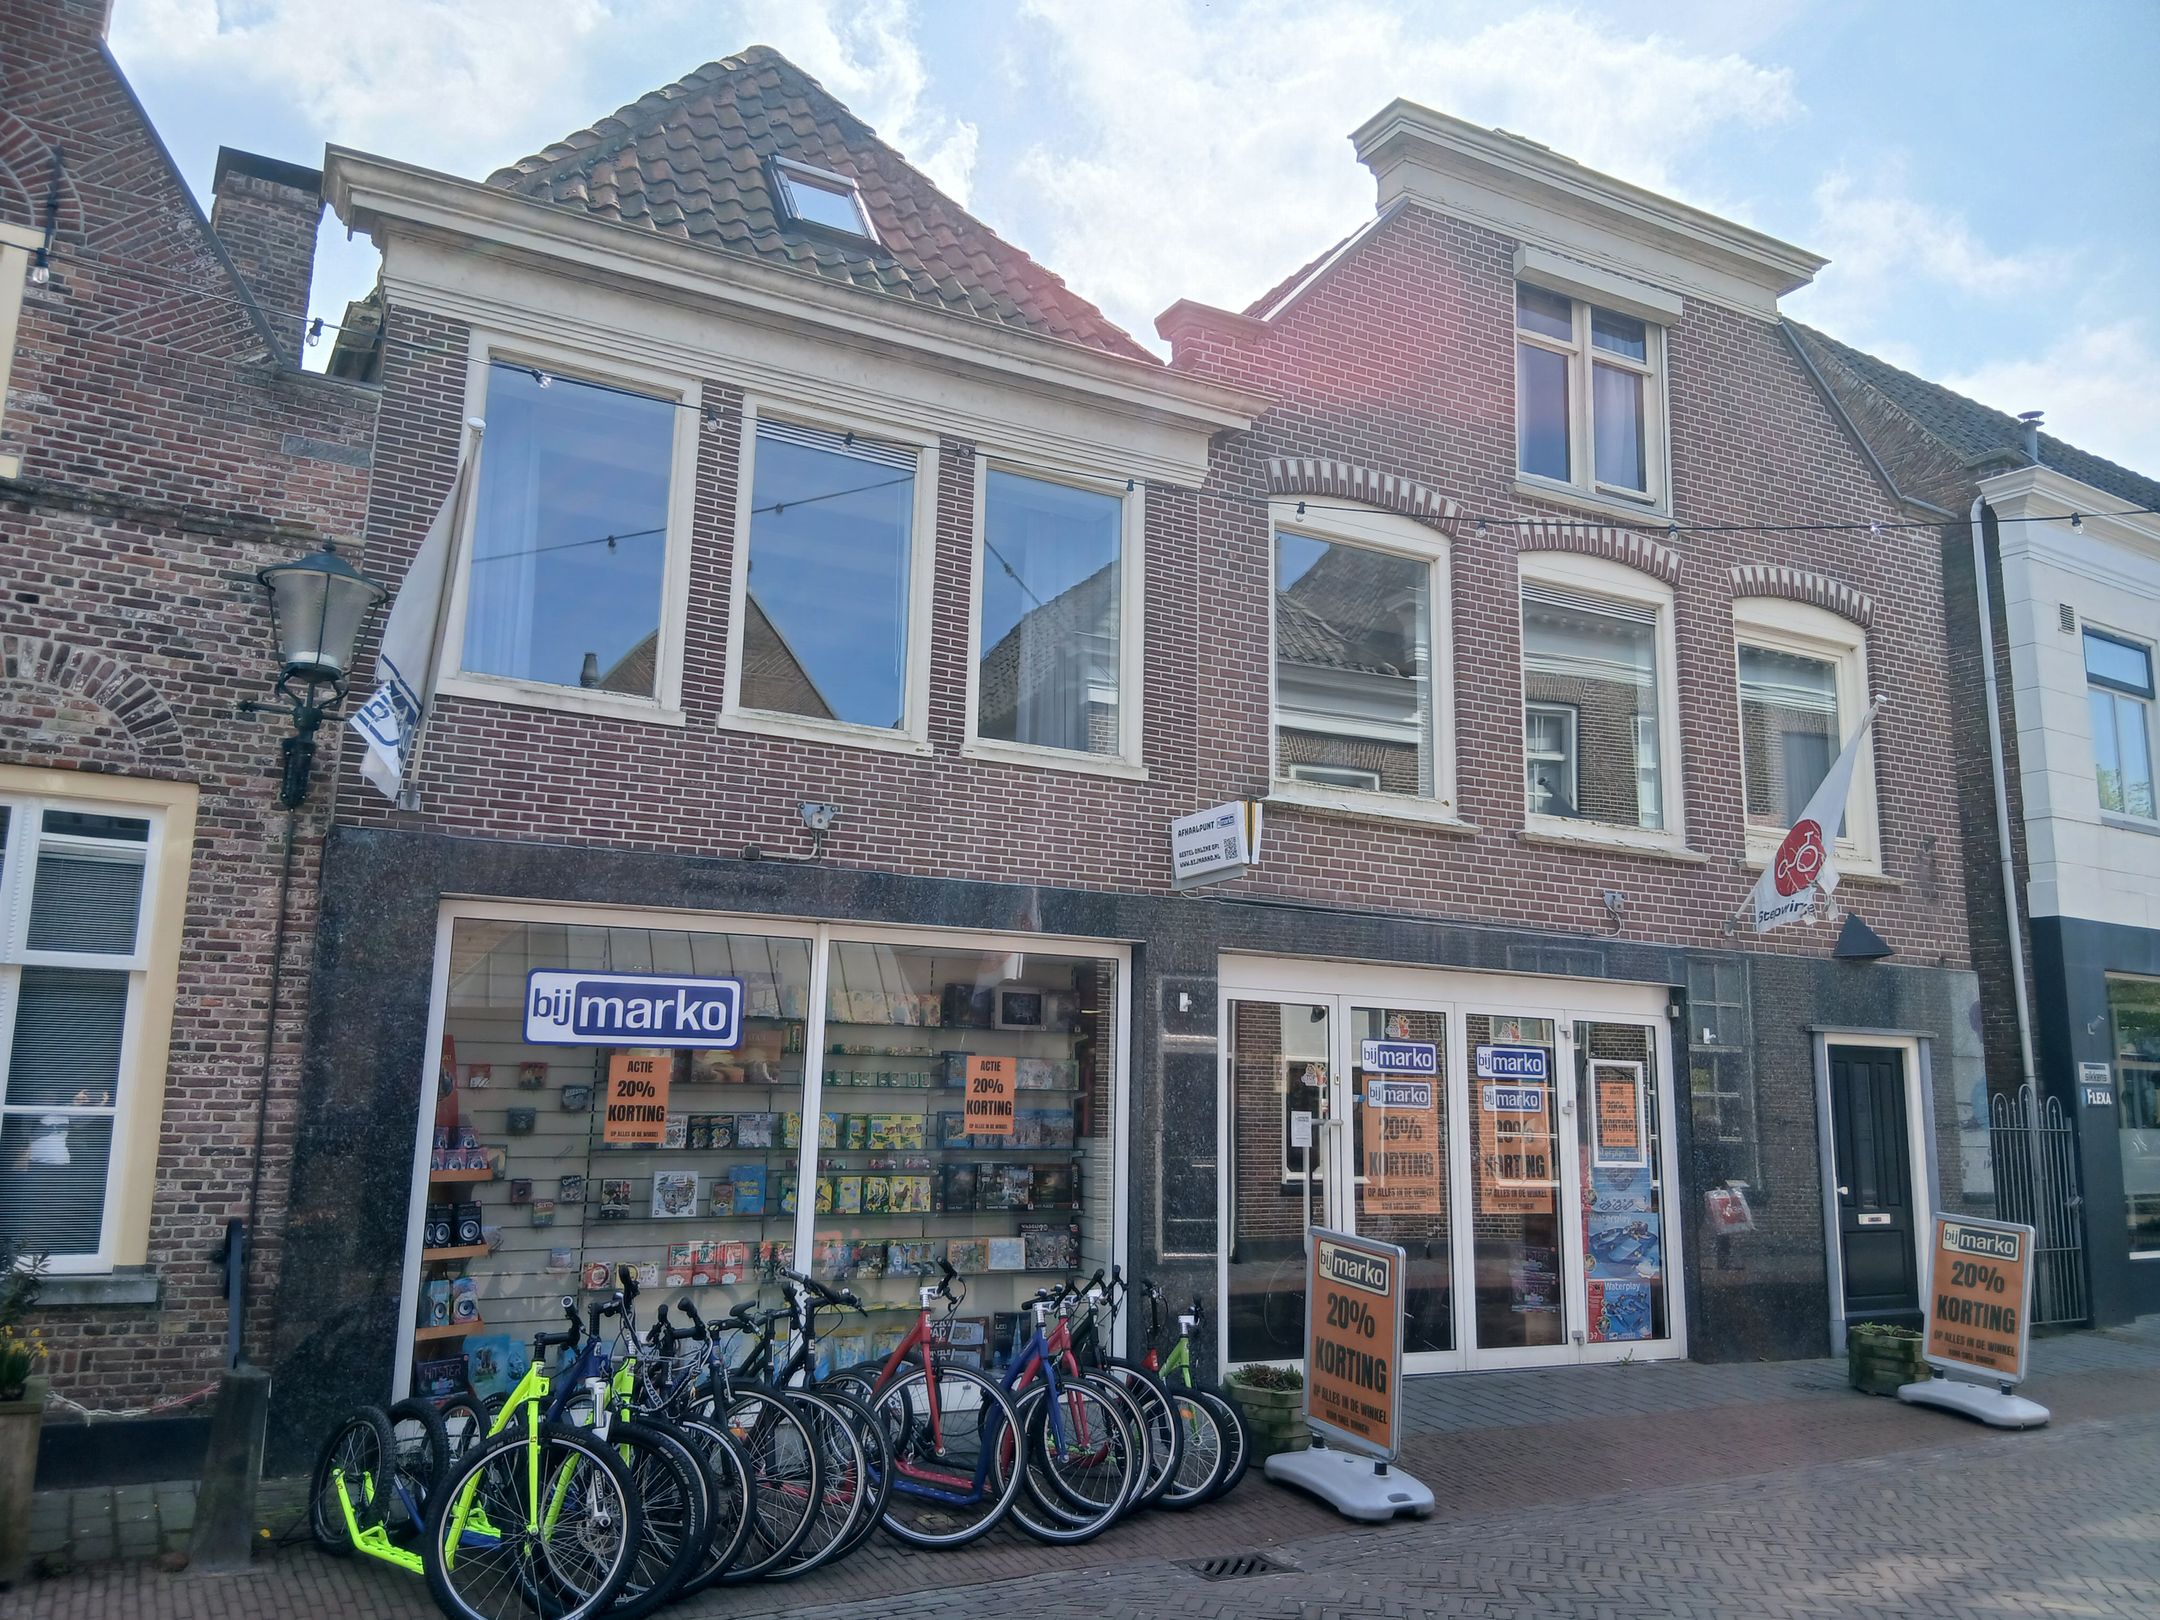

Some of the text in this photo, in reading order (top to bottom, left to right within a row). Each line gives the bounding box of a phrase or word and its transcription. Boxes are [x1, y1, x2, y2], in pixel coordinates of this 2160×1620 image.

[1178, 820, 1215, 838] AFHAALPUNT
[1179, 849, 1194, 858] BESTEL
[1195, 844, 1211, 854] ONLINE
[1179, 853, 1221, 868] WWW.BIJMARKO.NL
[627, 1061, 653, 1073] ACTIE
[980, 1061, 1001, 1071] ACTIE
[617, 1080, 655, 1098] 20%
[973, 1078, 1003, 1093] 20%
[608, 1104, 665, 1122] KORTING
[966, 1100, 1012, 1115] KORTING
[1379, 1116, 1422, 1141] 20%
[1369, 1152, 1434, 1176] KORTING
[1378, 1188, 1395, 1197] ALLES
[1494, 1189, 1510, 1197] ALLES
[1604, 1281, 1640, 1291] Waterplay
[1951, 1261, 2004, 1293] 20%
[1327, 1292, 1375, 1338] 20%
[1937, 1294, 2016, 1334] KORTING
[1945, 1332, 1965, 1345] ALLES
[1967, 1337, 1974, 1346] IN
[1976, 1339, 1985, 1349] DE
[1987, 1342, 2015, 1357] WINKEL
[424, 1364, 461, 1380] HITSTER
[1315, 1336, 1387, 1395] KORTING
[1322, 1387, 1340, 1405] ALLES
[1342, 1395, 1348, 1409] IN
[1351, 1399, 1359, 1413] DE
[1361, 1402, 1387, 1424] WINKEL
